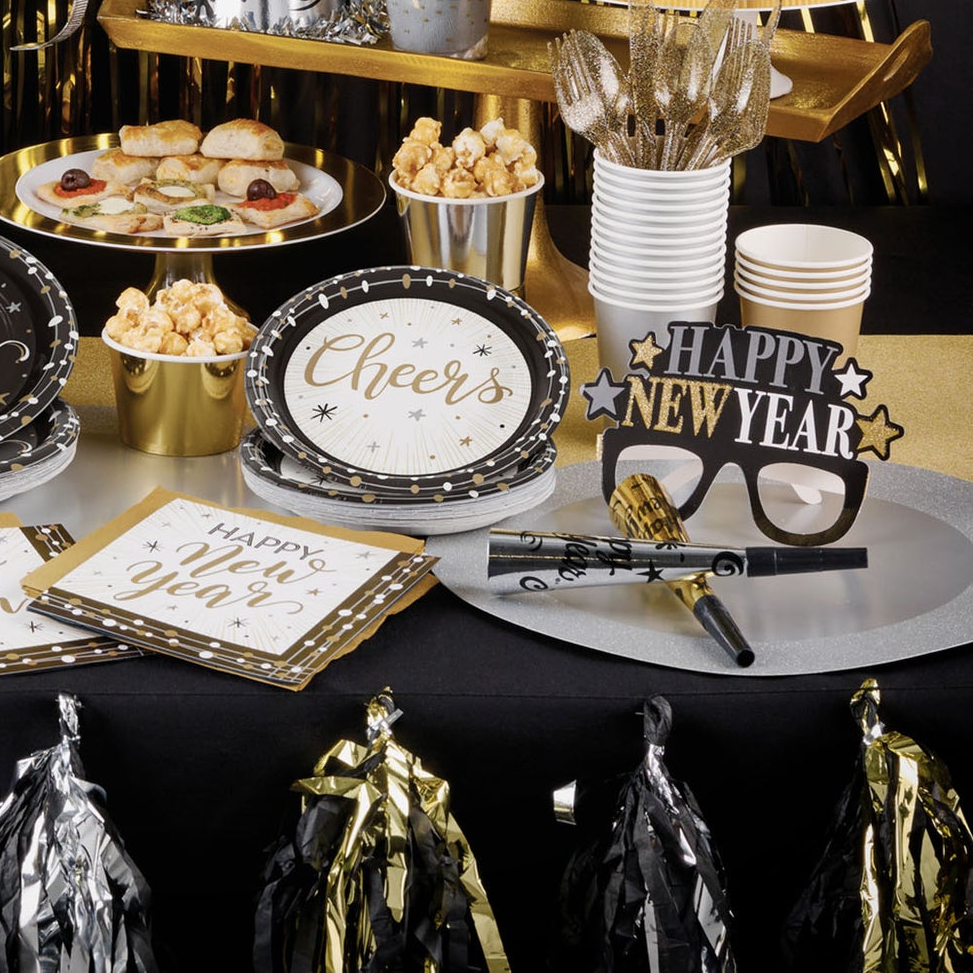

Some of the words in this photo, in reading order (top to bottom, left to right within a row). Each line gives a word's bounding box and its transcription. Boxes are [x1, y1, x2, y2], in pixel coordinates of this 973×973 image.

[304, 332, 513, 405] Cheers
[663, 326, 839, 395] HAPPY
[621, 377, 733, 439] NEW
[734, 387, 855, 460] YEAR
[176, 541, 335, 586] New
[207, 522, 326, 562] HAPPY
[113, 560, 304, 615] Year
